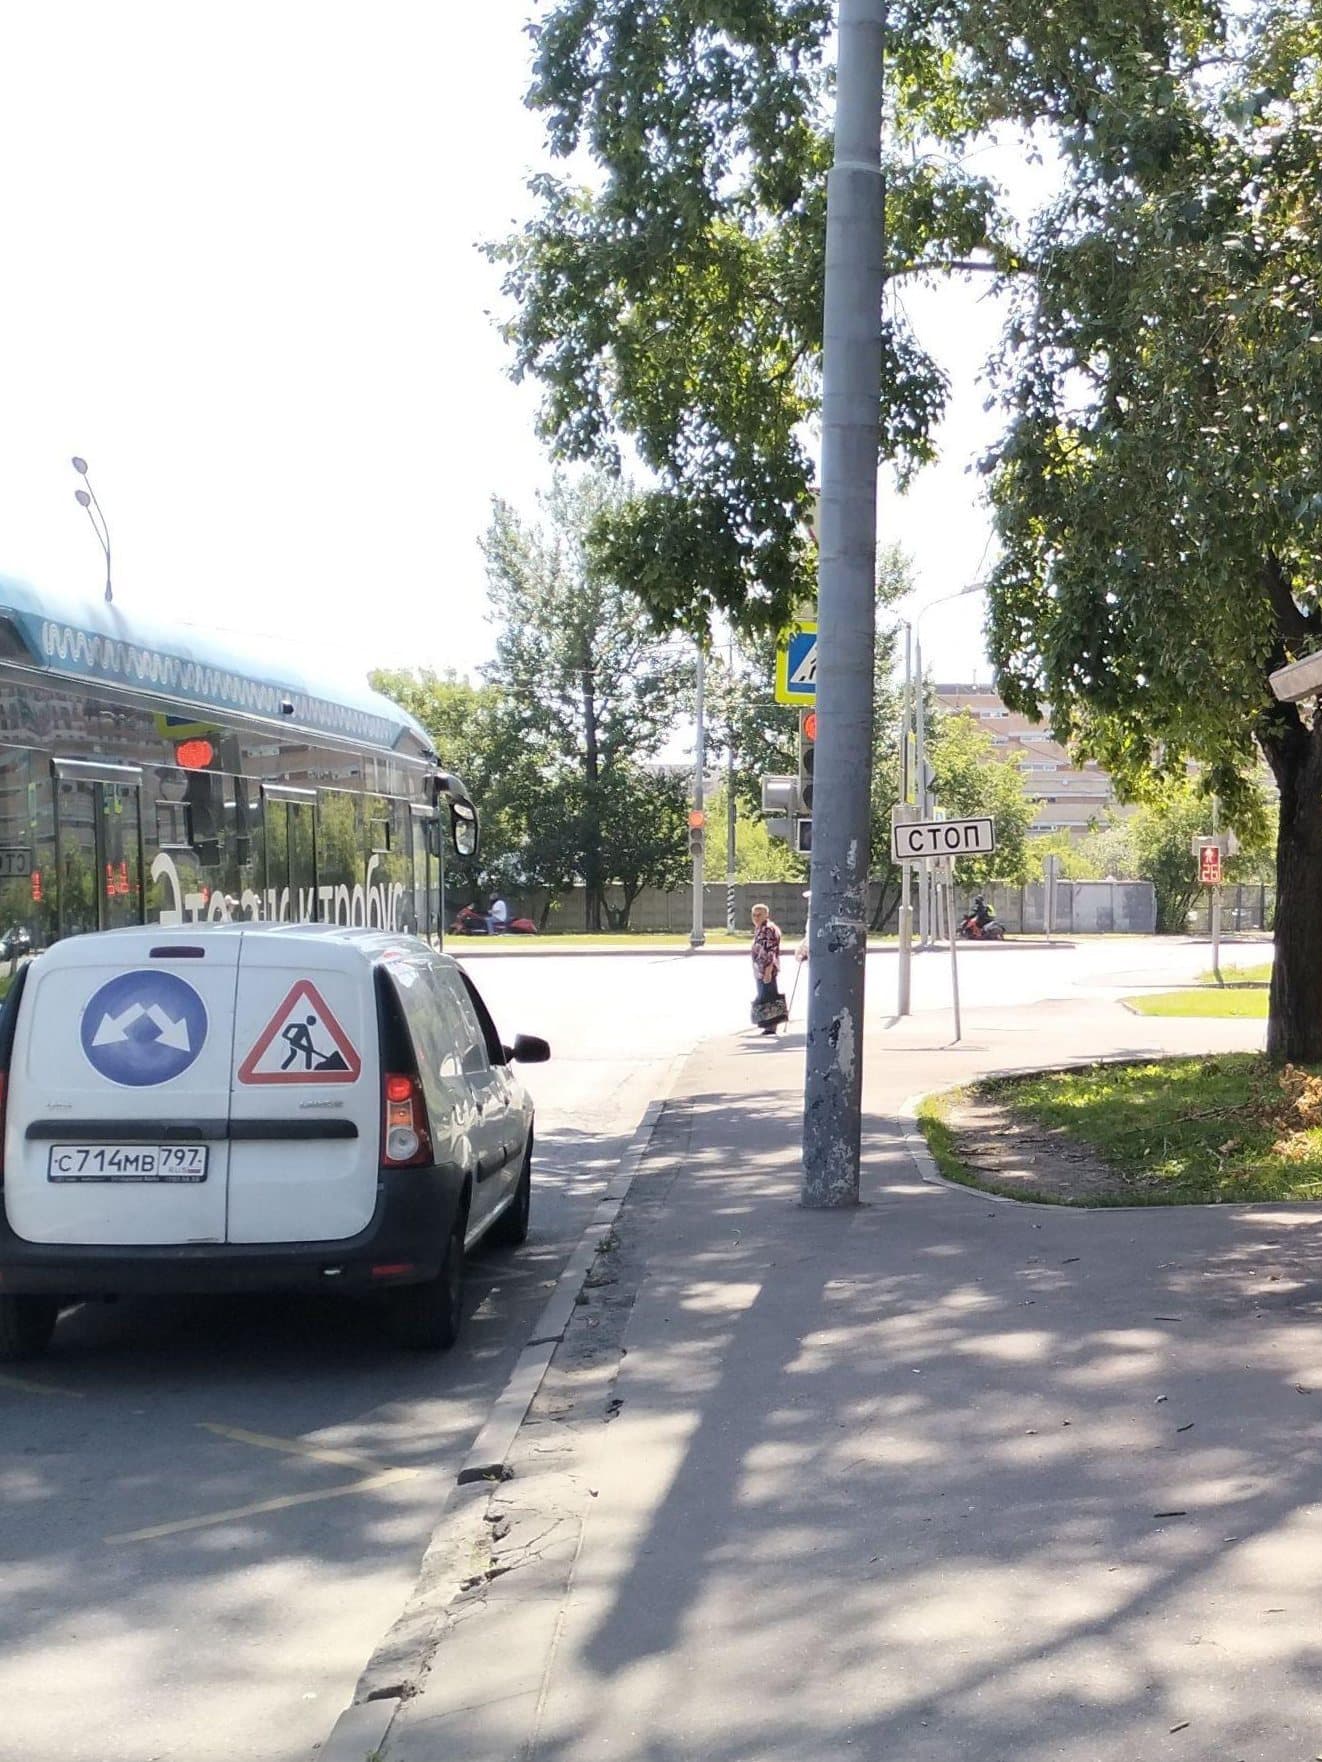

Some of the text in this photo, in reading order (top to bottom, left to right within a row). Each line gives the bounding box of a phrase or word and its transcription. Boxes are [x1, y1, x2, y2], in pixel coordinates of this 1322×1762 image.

[908, 825, 980, 851] СТОП
[1202, 863, 1219, 881] 26
[161, 1148, 201, 1168] 797
